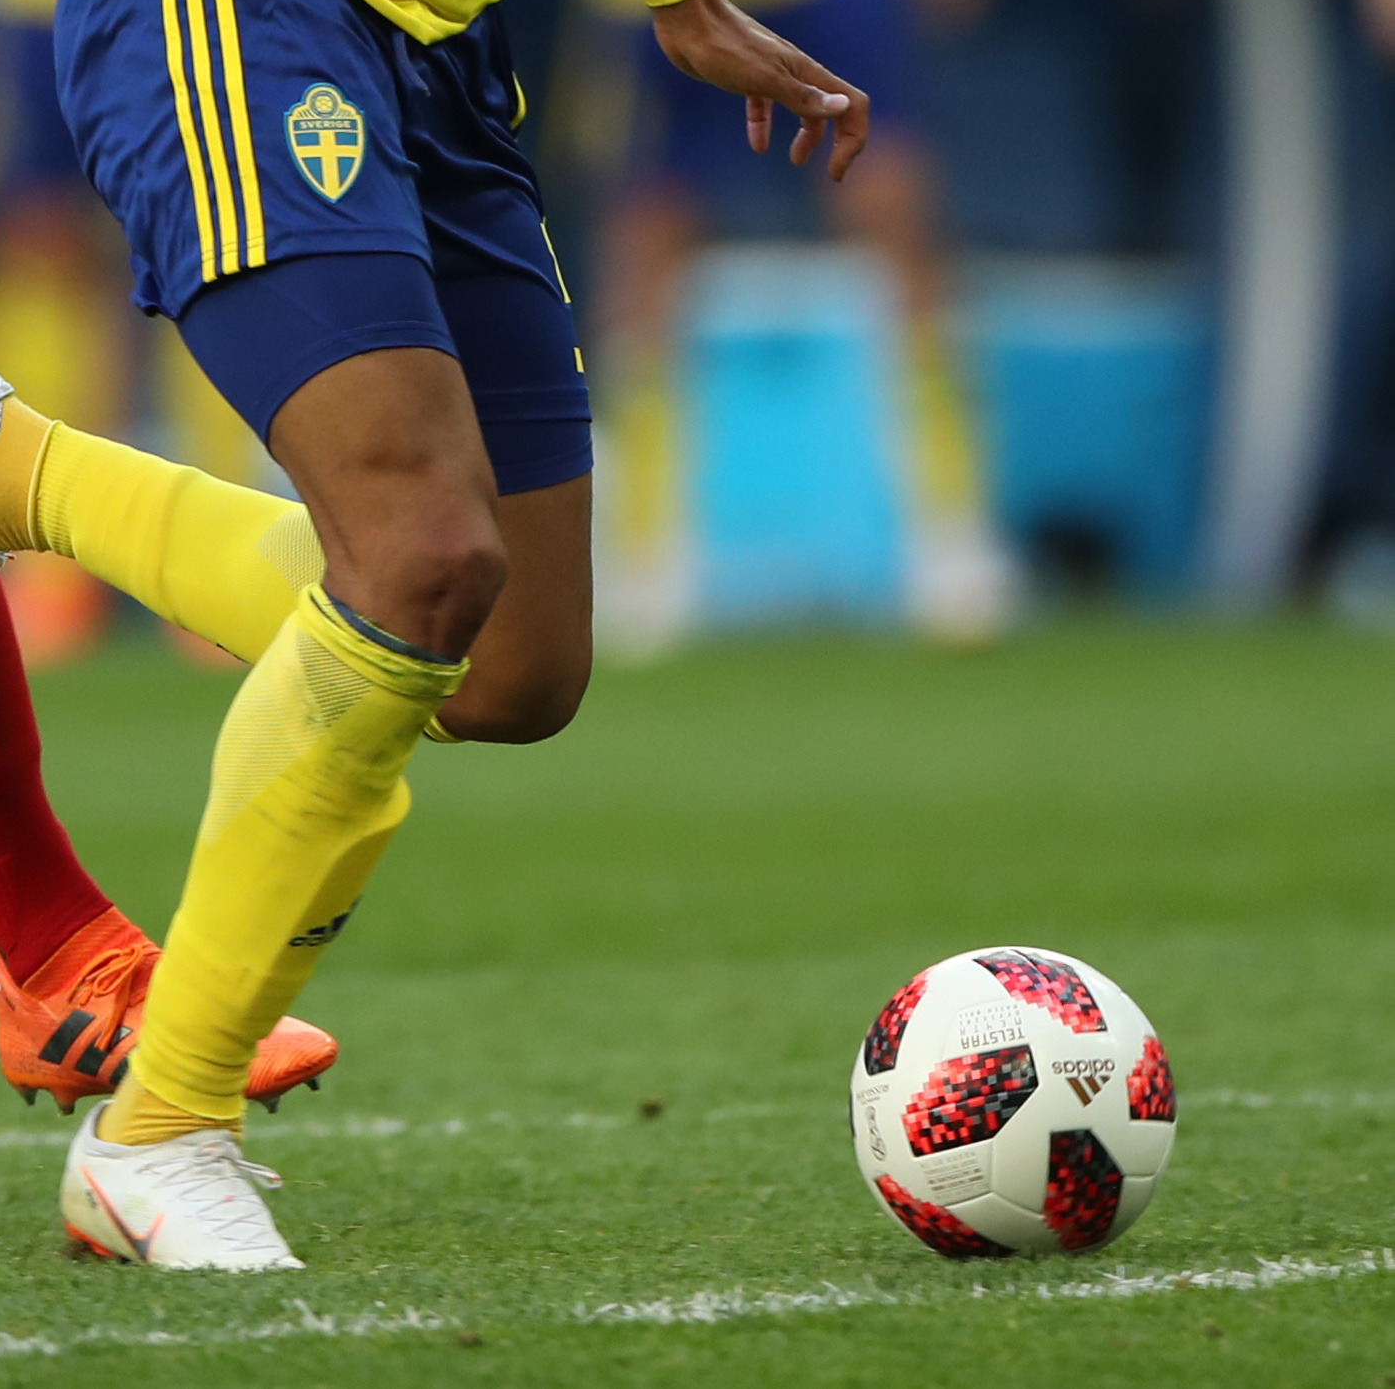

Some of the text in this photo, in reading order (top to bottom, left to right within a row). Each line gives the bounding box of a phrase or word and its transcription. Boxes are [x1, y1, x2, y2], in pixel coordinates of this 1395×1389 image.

[299, 120, 351, 129] SVERIGE
[960, 1027, 1025, 1050] TELSTAR
[1051, 1058, 1116, 1077] adidas
